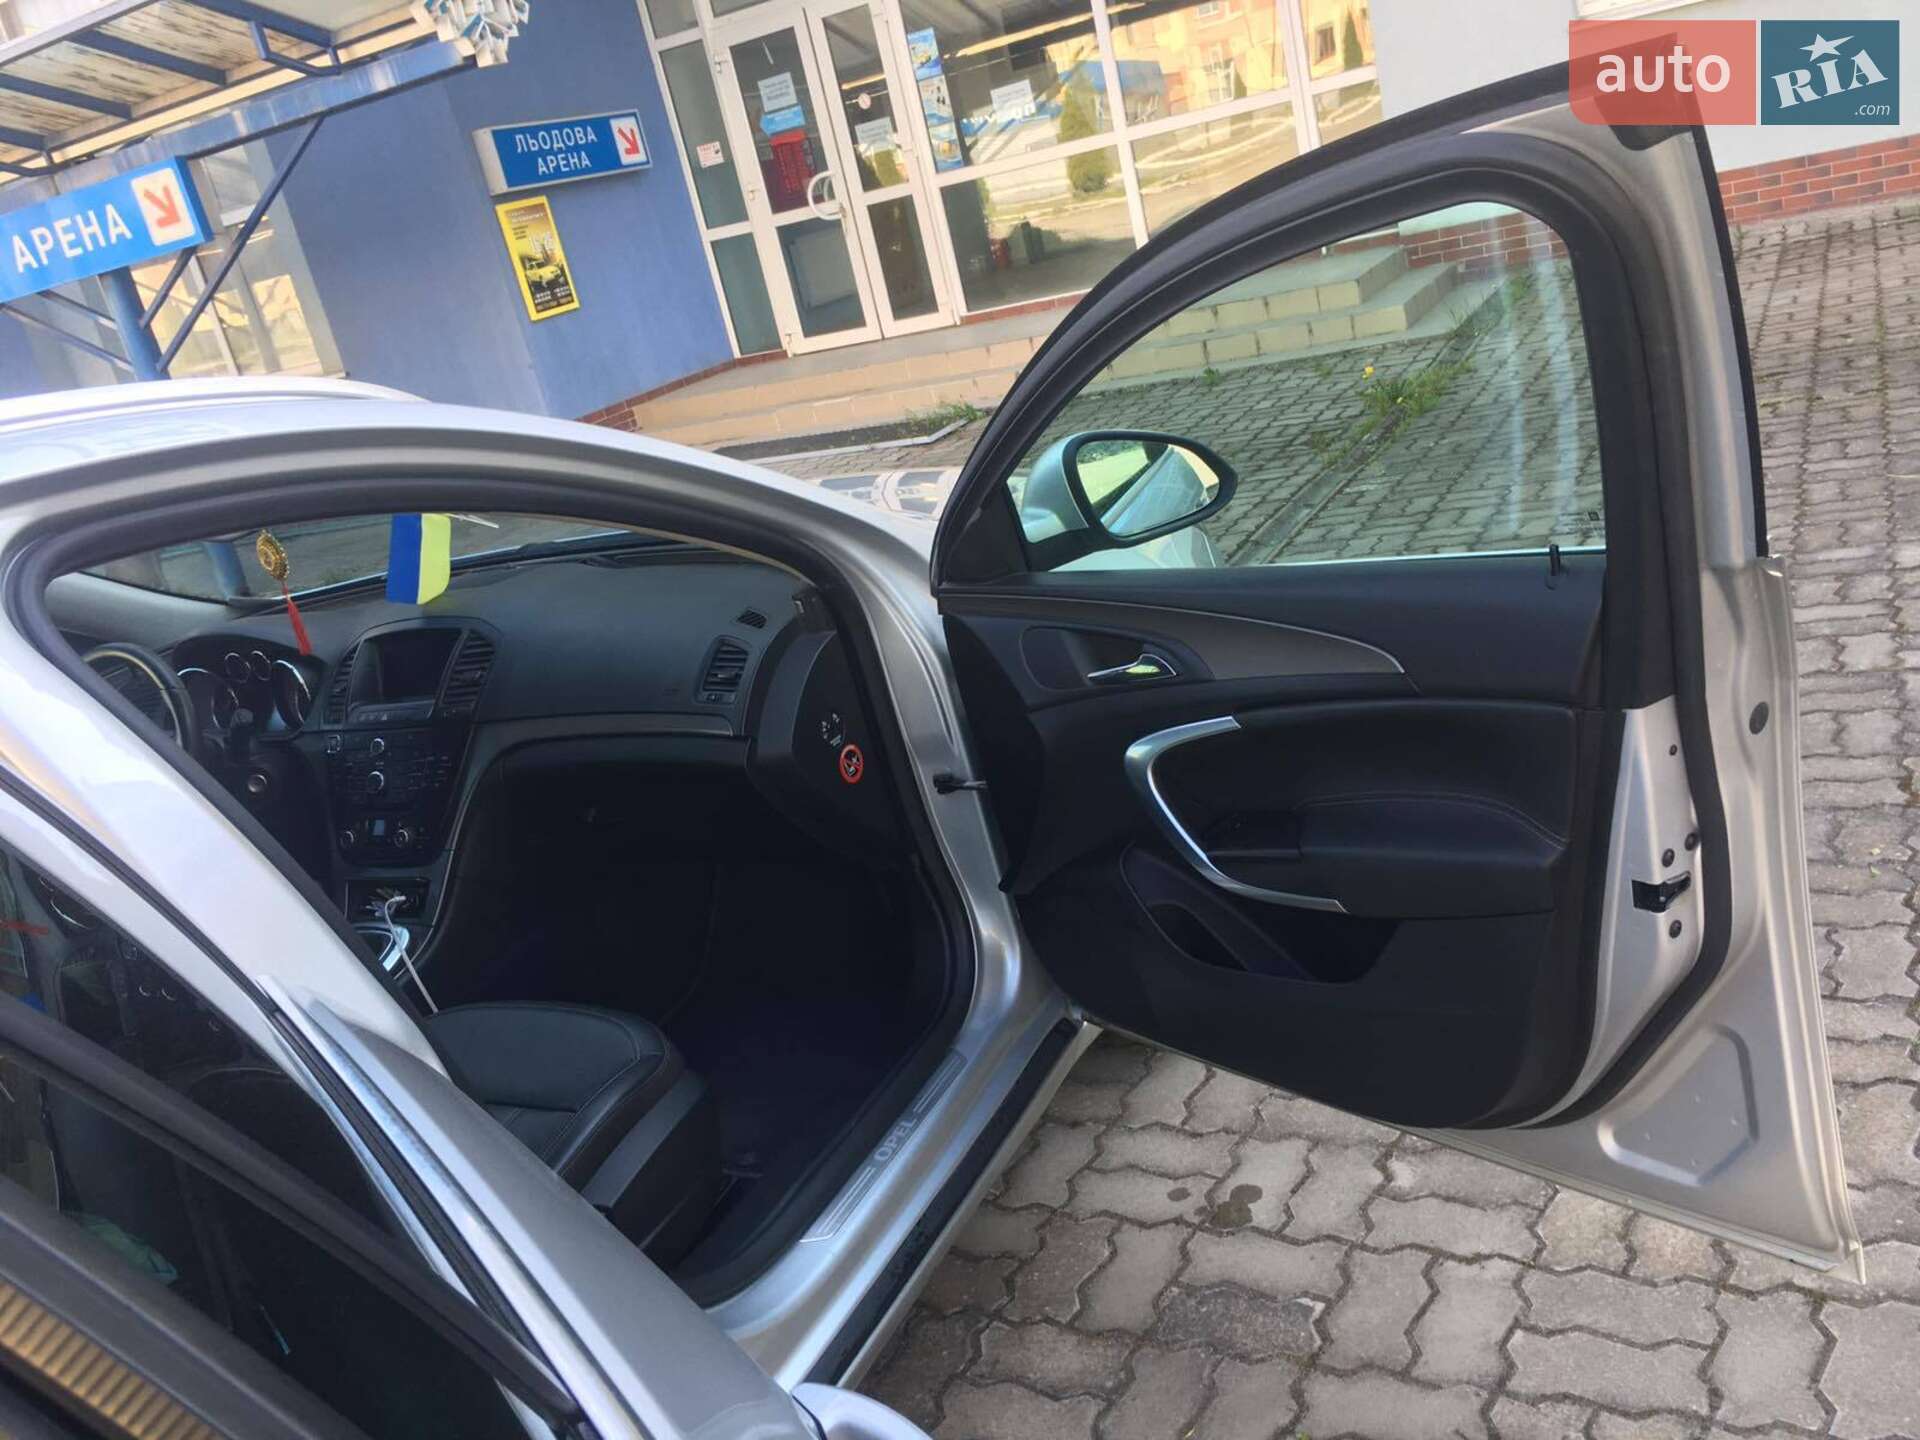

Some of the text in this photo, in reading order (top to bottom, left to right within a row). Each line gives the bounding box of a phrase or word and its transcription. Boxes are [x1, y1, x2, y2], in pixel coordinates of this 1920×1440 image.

[515, 125, 598, 154] ЛЬОДОВА
[537, 151, 593, 176] АРЕНА
[12, 203, 133, 273] АРЕНА
[873, 1120, 914, 1161] OPEL
